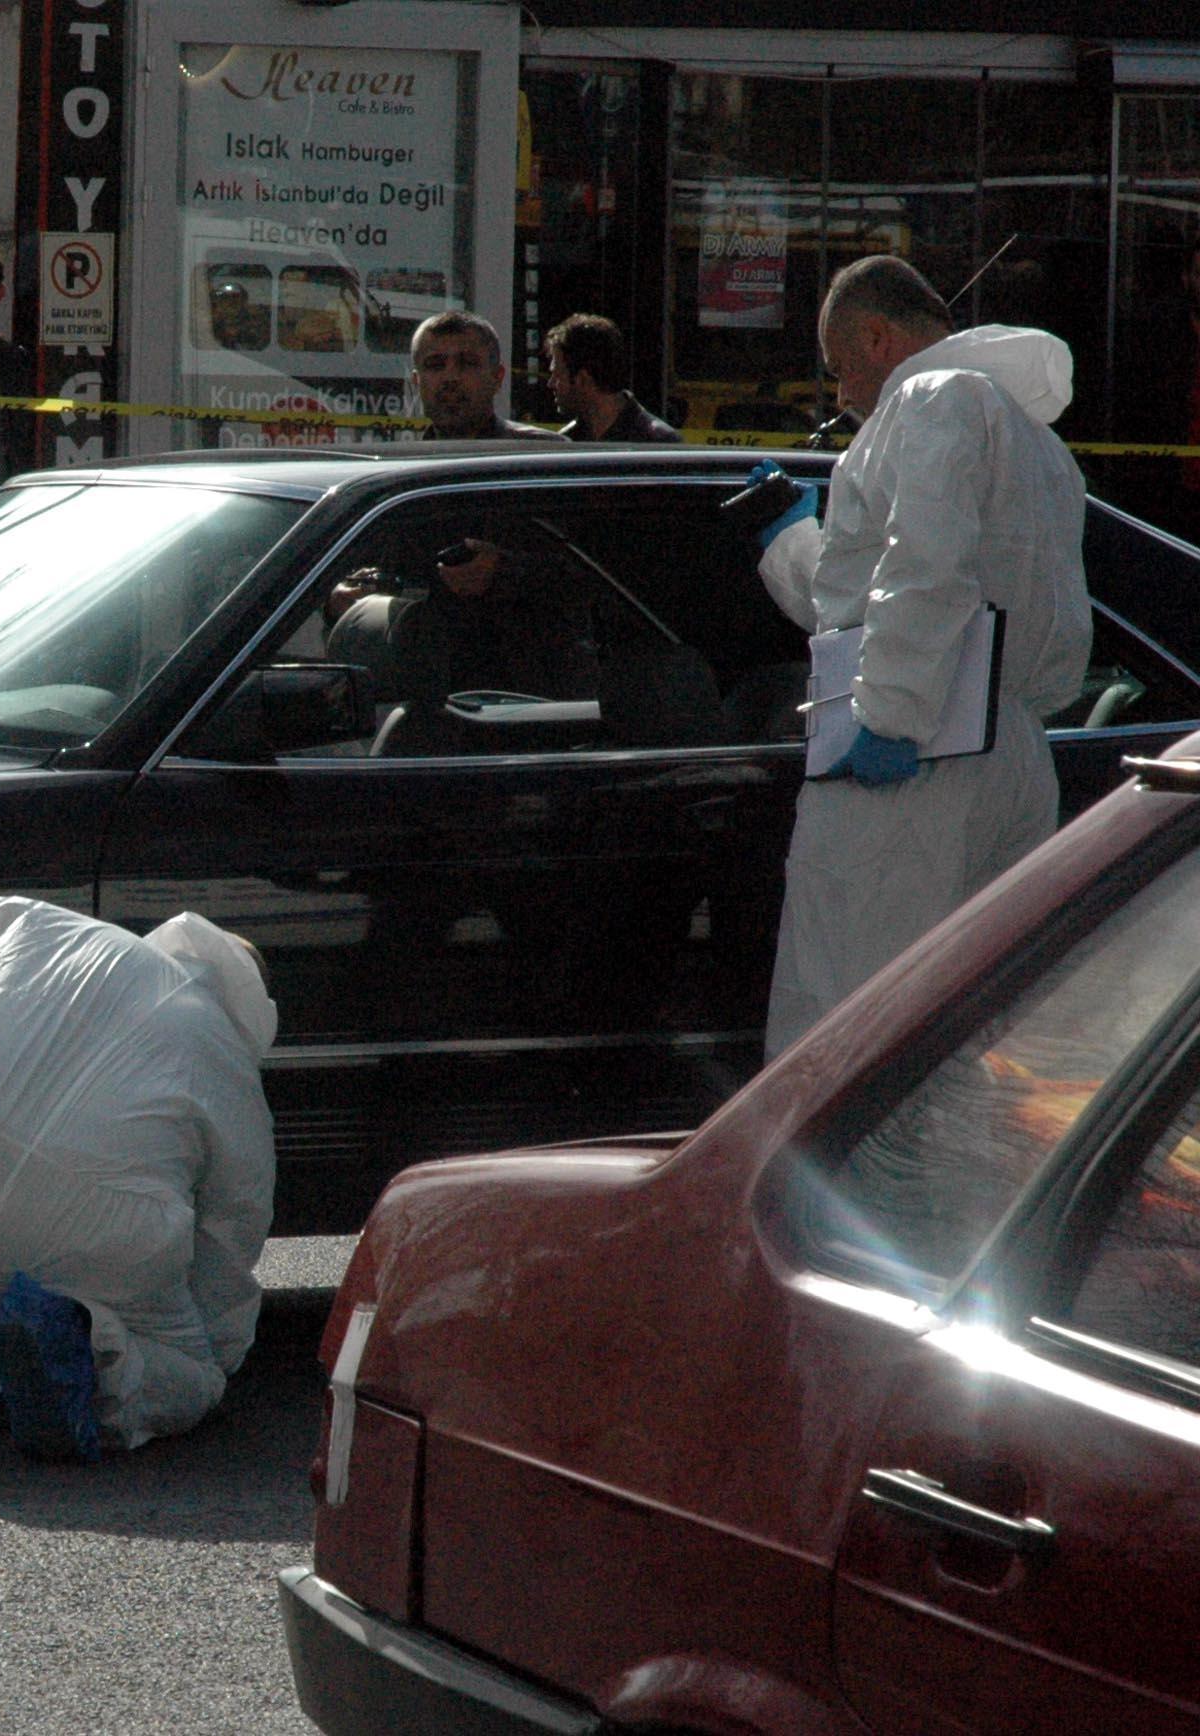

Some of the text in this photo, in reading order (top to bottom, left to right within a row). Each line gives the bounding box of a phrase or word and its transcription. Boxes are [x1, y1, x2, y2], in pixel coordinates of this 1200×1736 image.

[221, 50, 416, 101] Heaven
[338, 99, 367, 113] Cafe
[383, 100, 415, 115] Bistro
[226, 132, 416, 167] Islak Hamburger
[193, 179, 243, 201] Artık
[379, 182, 445, 212] Değil
[250, 220, 388, 246] Heaven'da
